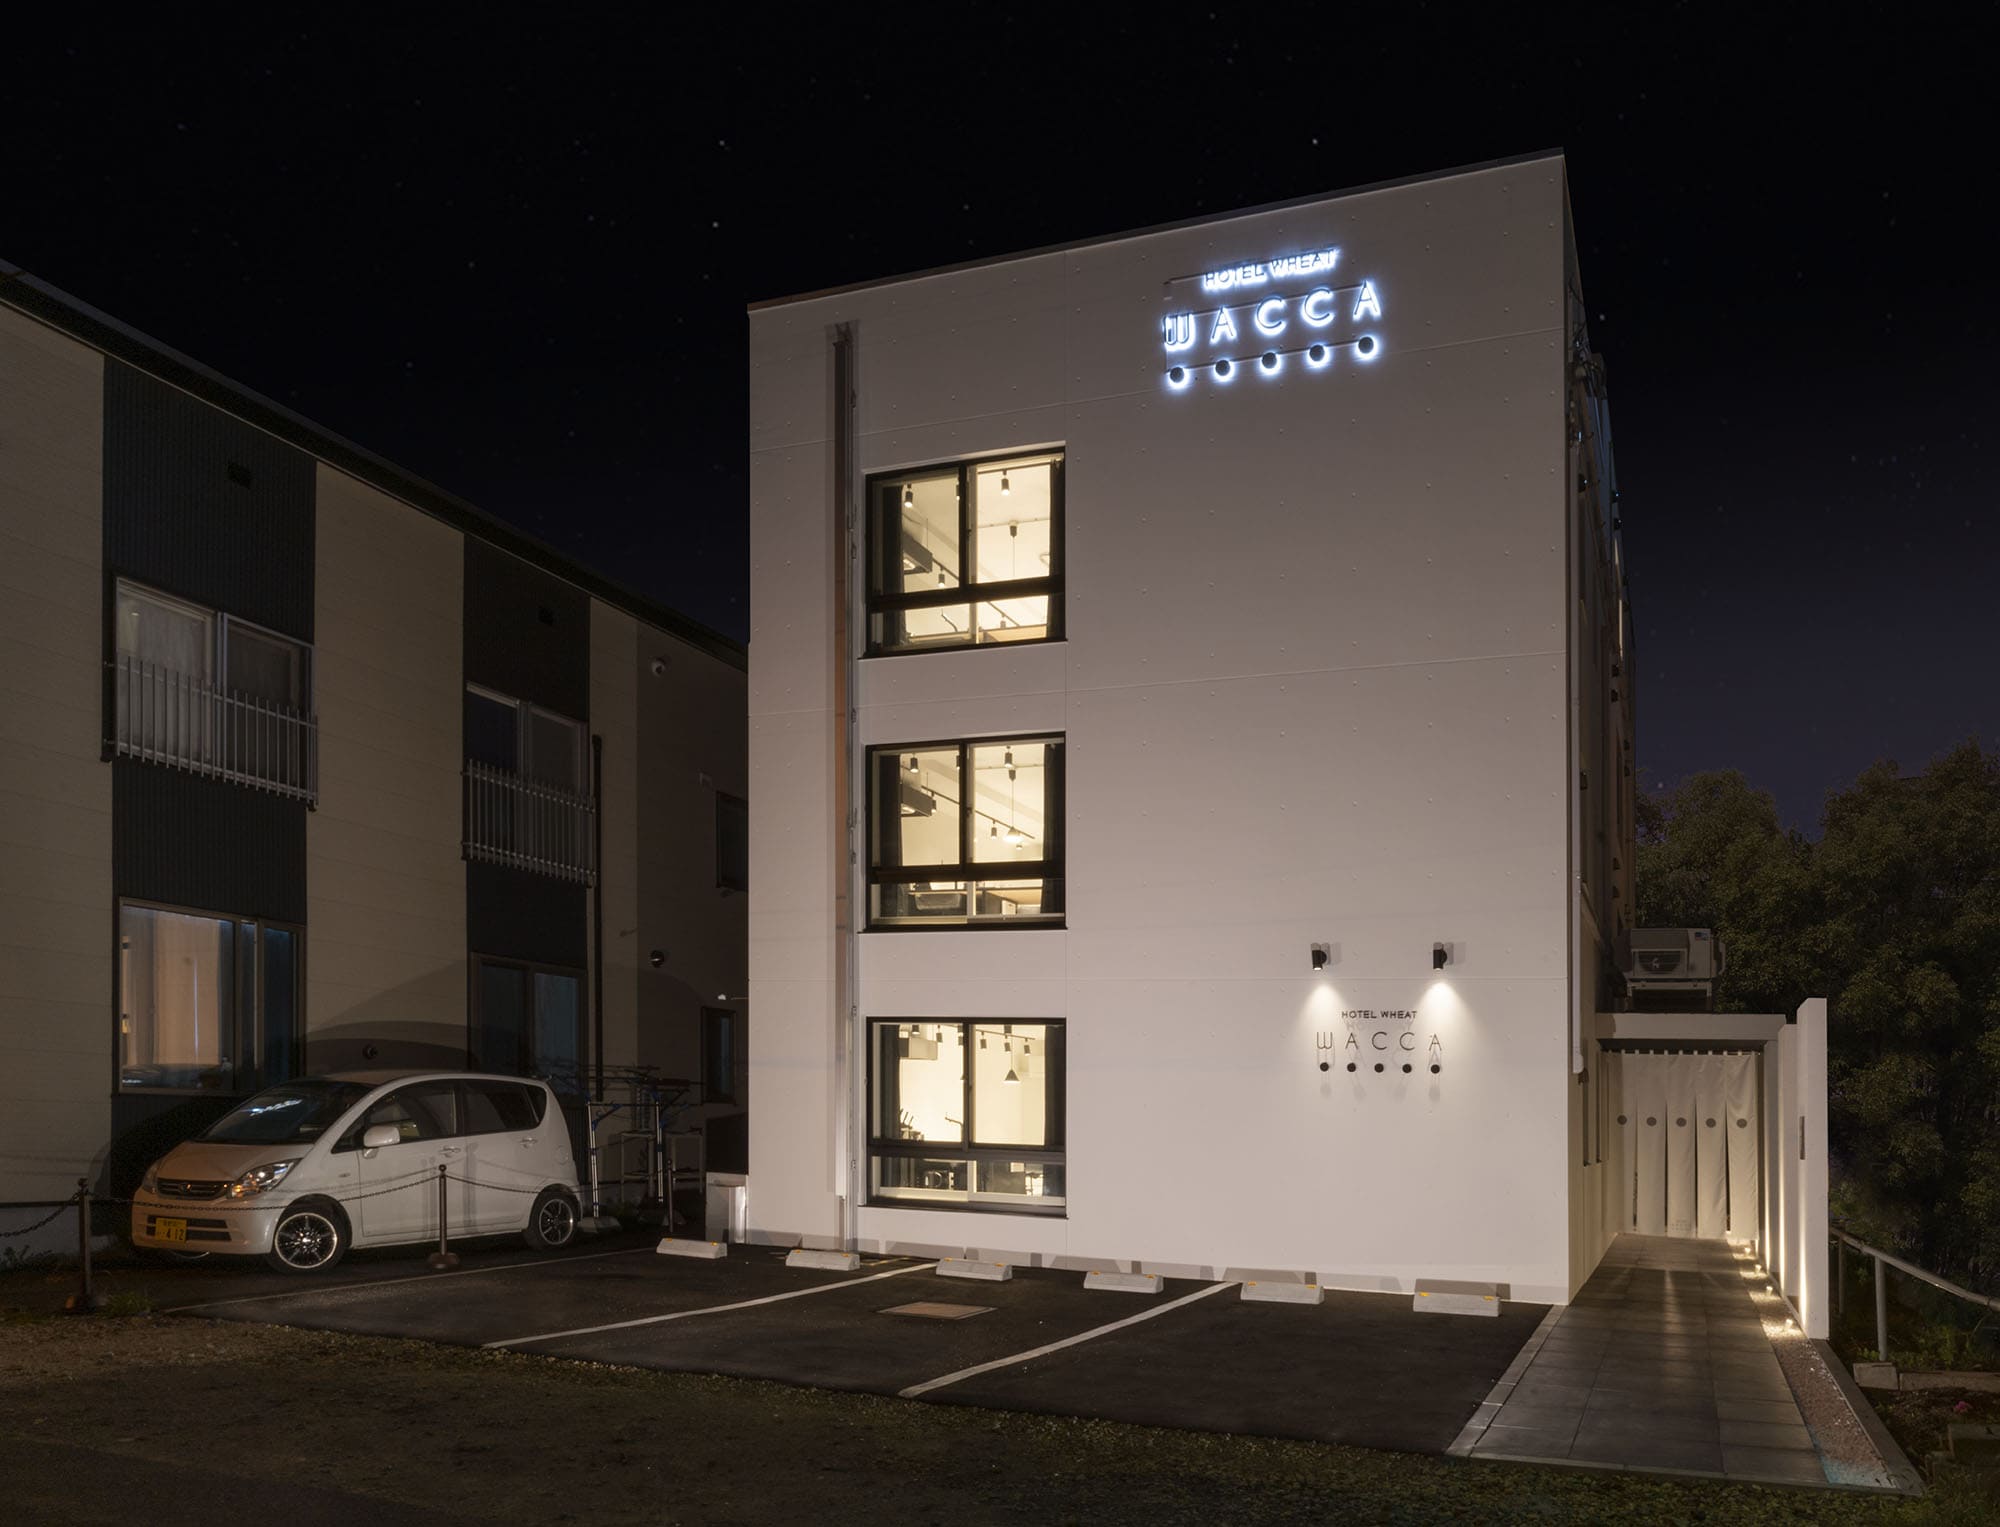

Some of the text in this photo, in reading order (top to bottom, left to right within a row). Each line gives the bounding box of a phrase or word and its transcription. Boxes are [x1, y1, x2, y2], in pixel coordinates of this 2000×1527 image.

[1203, 248, 1338, 289] HOTEL WHEAT
[1163, 281, 1380, 349] WACCA
[1341, 1010, 1418, 1019] HOTEL WHEAT
[1316, 1031, 1442, 1051] WACCA
